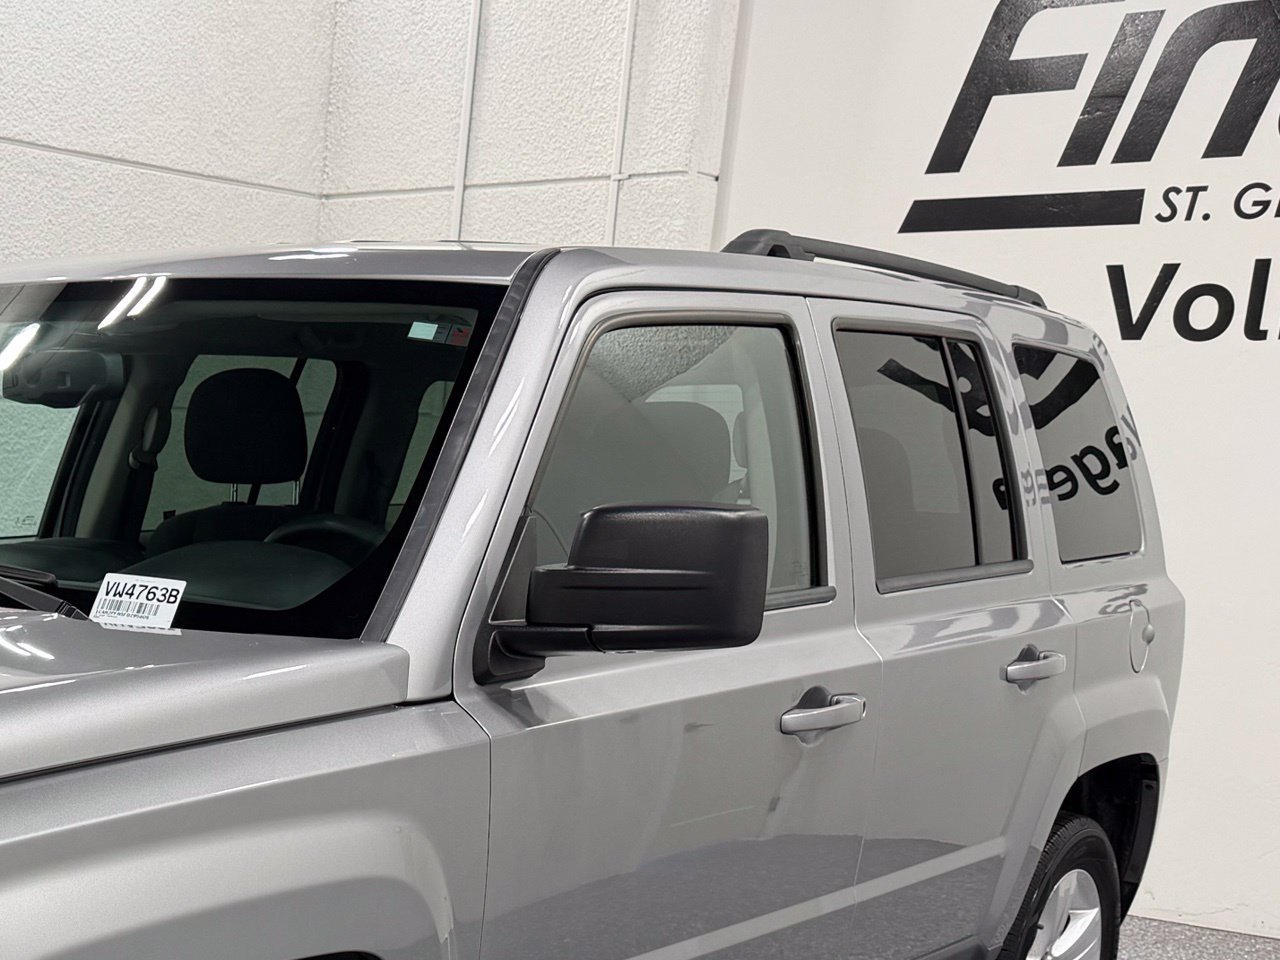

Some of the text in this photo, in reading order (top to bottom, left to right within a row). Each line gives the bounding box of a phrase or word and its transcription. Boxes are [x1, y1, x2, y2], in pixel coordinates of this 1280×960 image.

[924, 0, 1280, 174] Fin
[1154, 181, 1280, 223] ST. G
[1106, 258, 1280, 342] Vol
[105, 581, 180, 604] VW4763B
